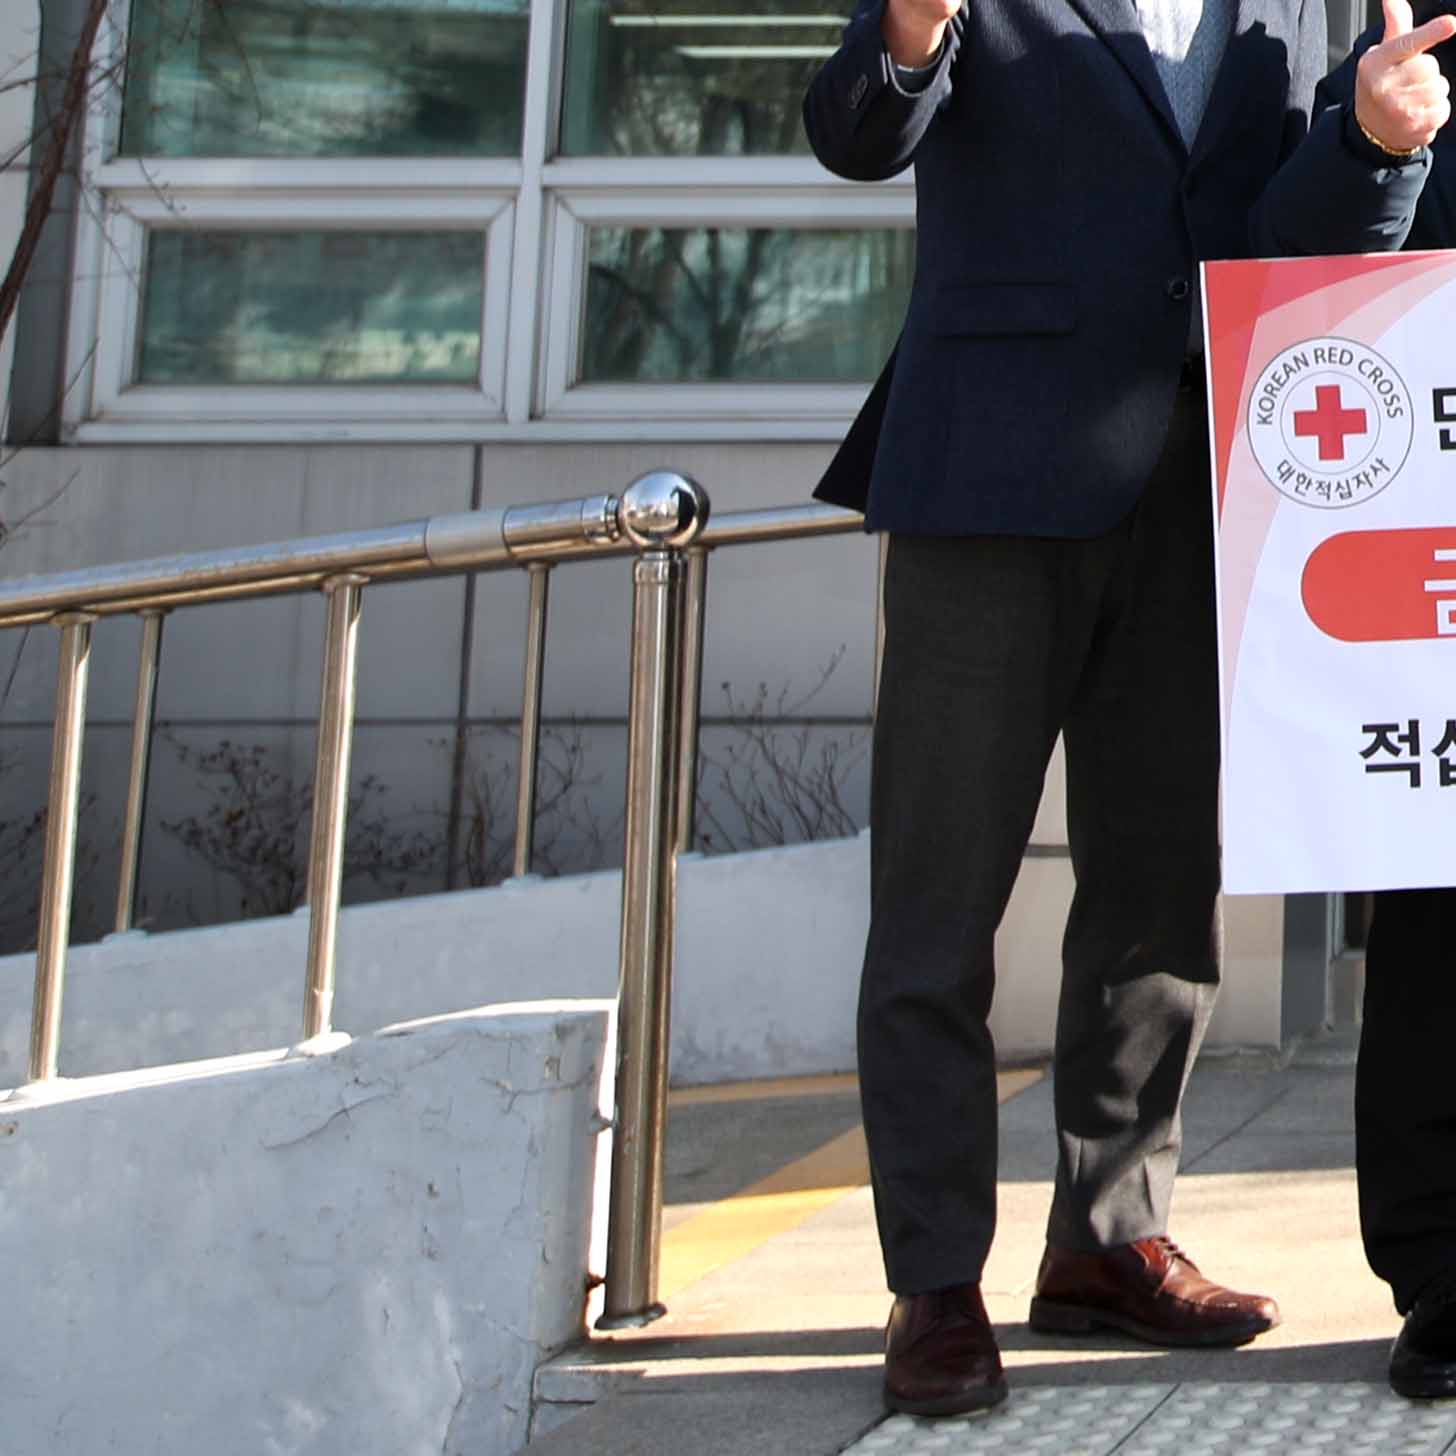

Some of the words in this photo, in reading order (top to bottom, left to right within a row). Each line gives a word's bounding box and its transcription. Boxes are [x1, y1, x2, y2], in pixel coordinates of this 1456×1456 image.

[1257, 351, 1310, 425] KOREAN
[1313, 347, 1354, 366] RED
[1358, 358, 1404, 420] CROSS
[1277, 457, 1391, 501] 대한적십자사
